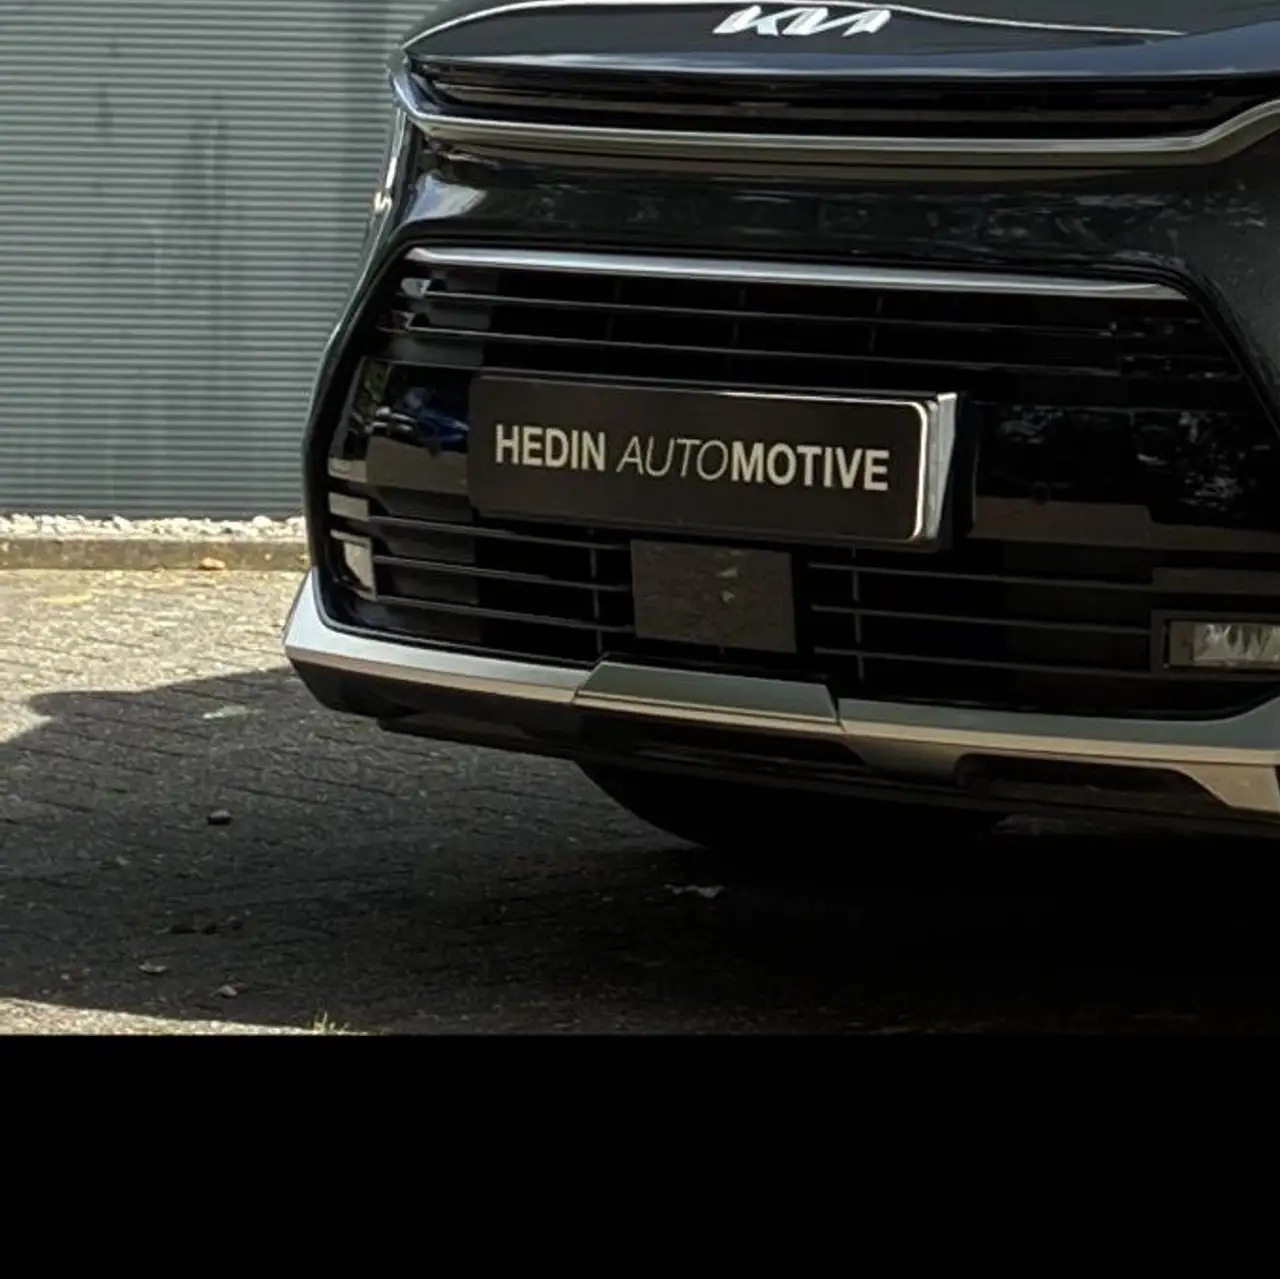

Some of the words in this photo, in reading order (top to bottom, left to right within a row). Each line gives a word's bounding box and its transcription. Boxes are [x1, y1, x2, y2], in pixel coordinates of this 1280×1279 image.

[713, 5, 891, 37] KIA
[495, 424, 605, 472] HEDIN
[616, 435, 890, 492] AUTOMOTIVE
